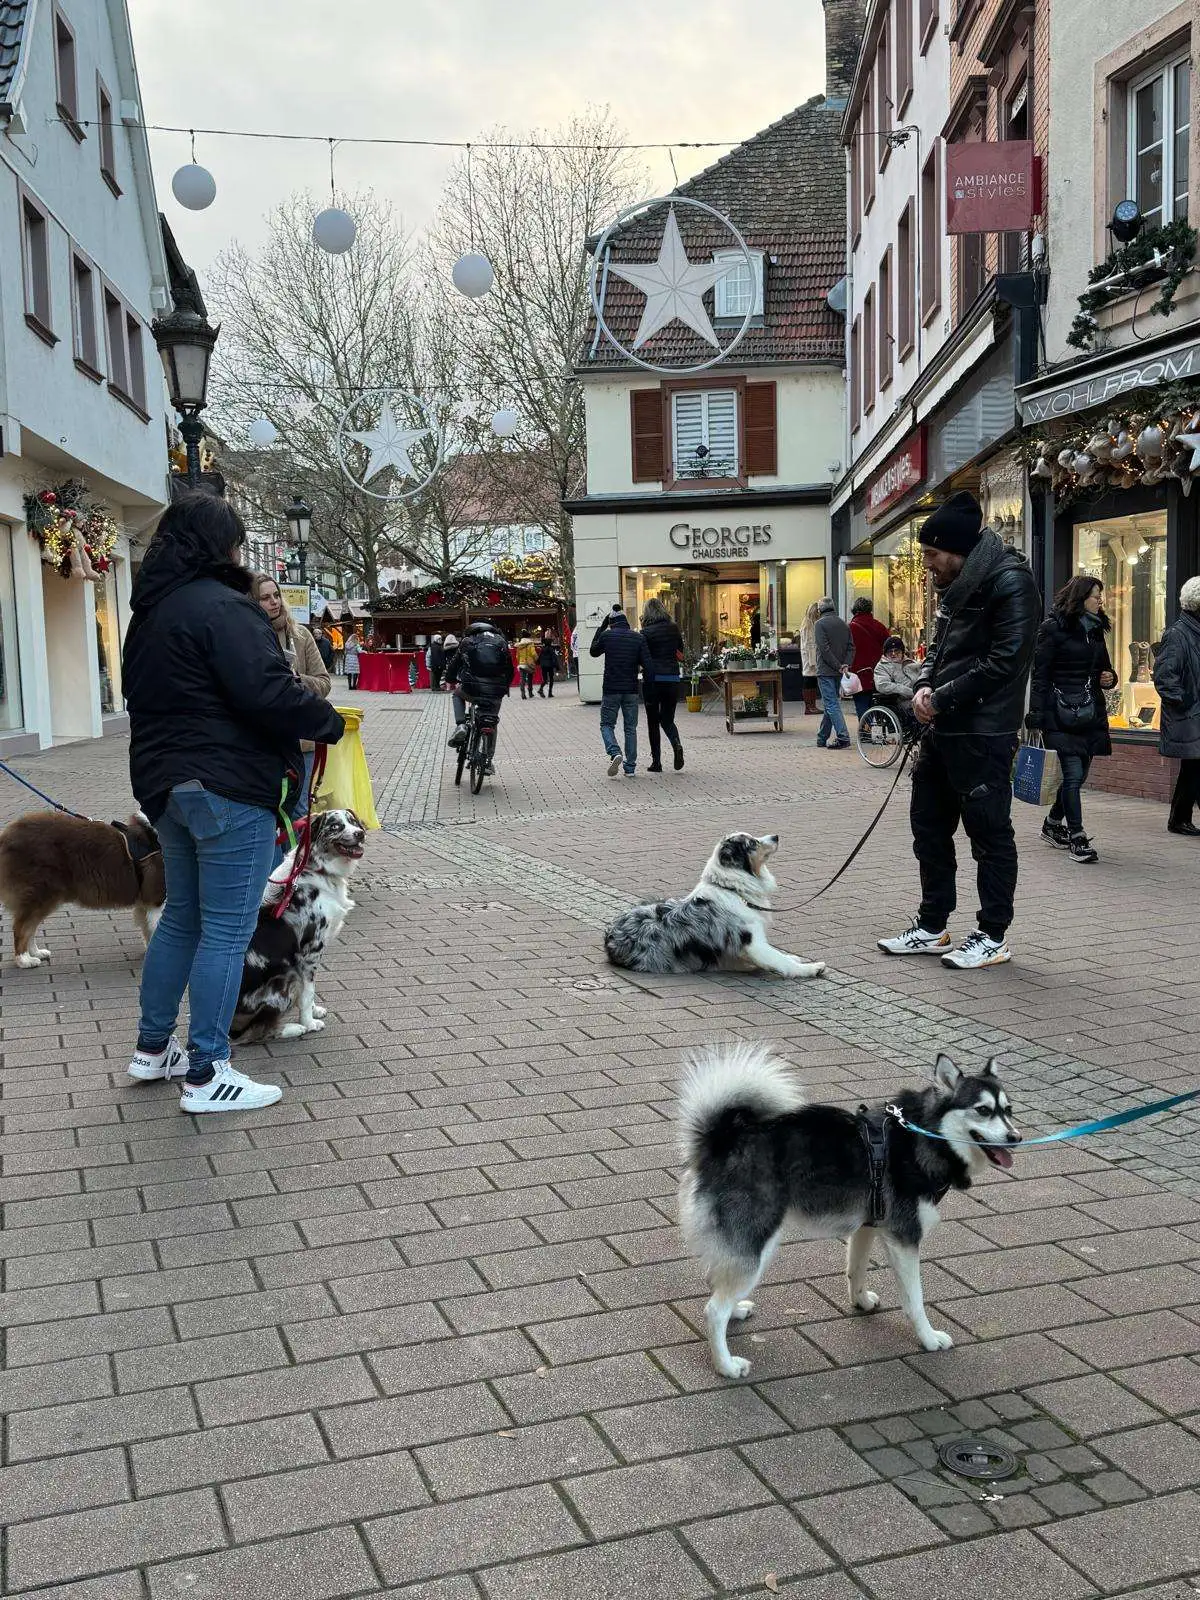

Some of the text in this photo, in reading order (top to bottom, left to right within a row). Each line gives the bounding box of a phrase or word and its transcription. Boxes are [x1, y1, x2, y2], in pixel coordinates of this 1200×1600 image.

[955, 172, 1025, 187] AMBIANCE
[1027, 350, 1194, 421] WOHLFROM
[692, 547, 749, 559] CHAUSSURES
